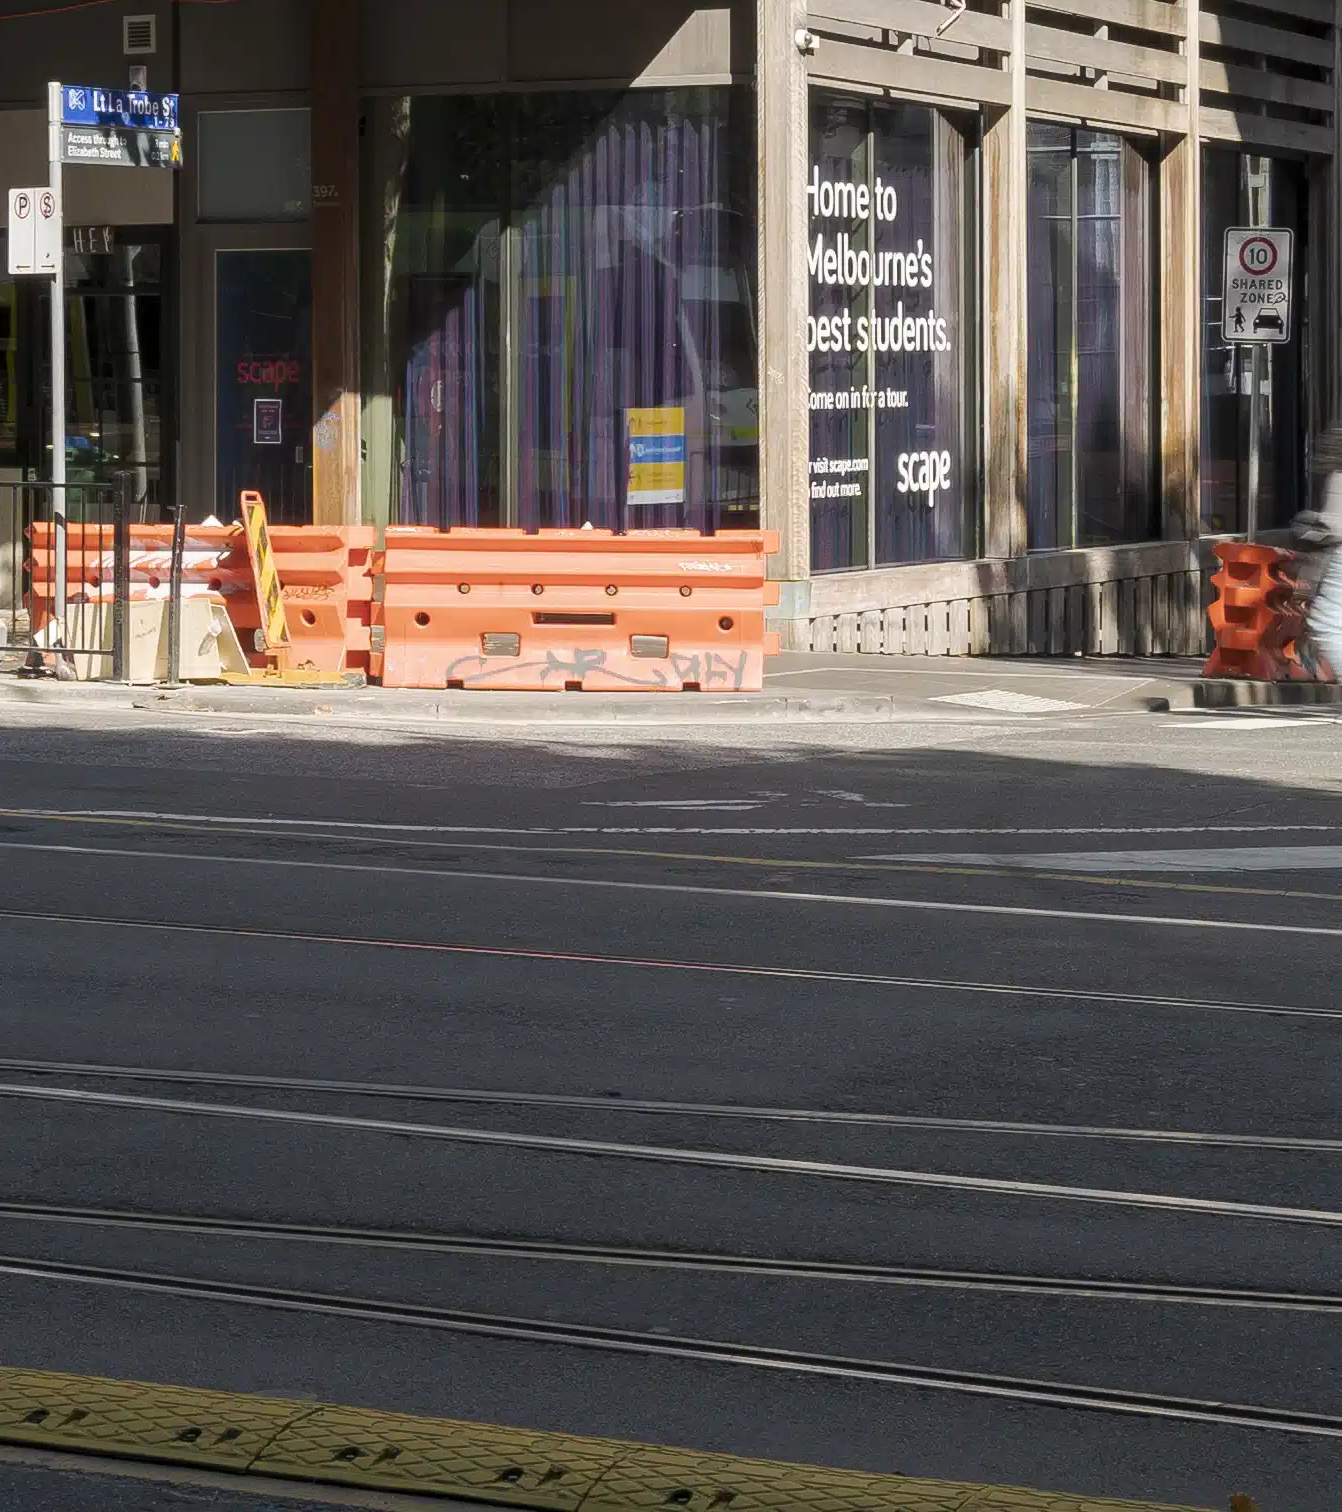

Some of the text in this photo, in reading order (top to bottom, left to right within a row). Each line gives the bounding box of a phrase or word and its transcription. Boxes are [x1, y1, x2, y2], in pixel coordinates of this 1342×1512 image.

[93, 90, 175, 117] Lt La Trobe St
[68, 131, 93, 144] Access
[68, 145, 122, 159] Elizabeth Street
[875, 176, 898, 221] to
[808, 232, 933, 288] Melbourne's
[1248, 247, 1268, 265] 10
[1231, 278, 1284, 291] SHARED
[1239, 292, 1274, 305] ZONE
[856, 300, 952, 353] students.
[235, 360, 300, 392] scape
[835, 391, 849, 409] on
[850, 385, 861, 409] in
[861, 384, 877, 408] for
[878, 391, 886, 408] a
[813, 457, 829, 474] visit
[829, 458, 869, 477] scape.com
[827, 481, 840, 498] out
[897, 450, 951, 508] scape
